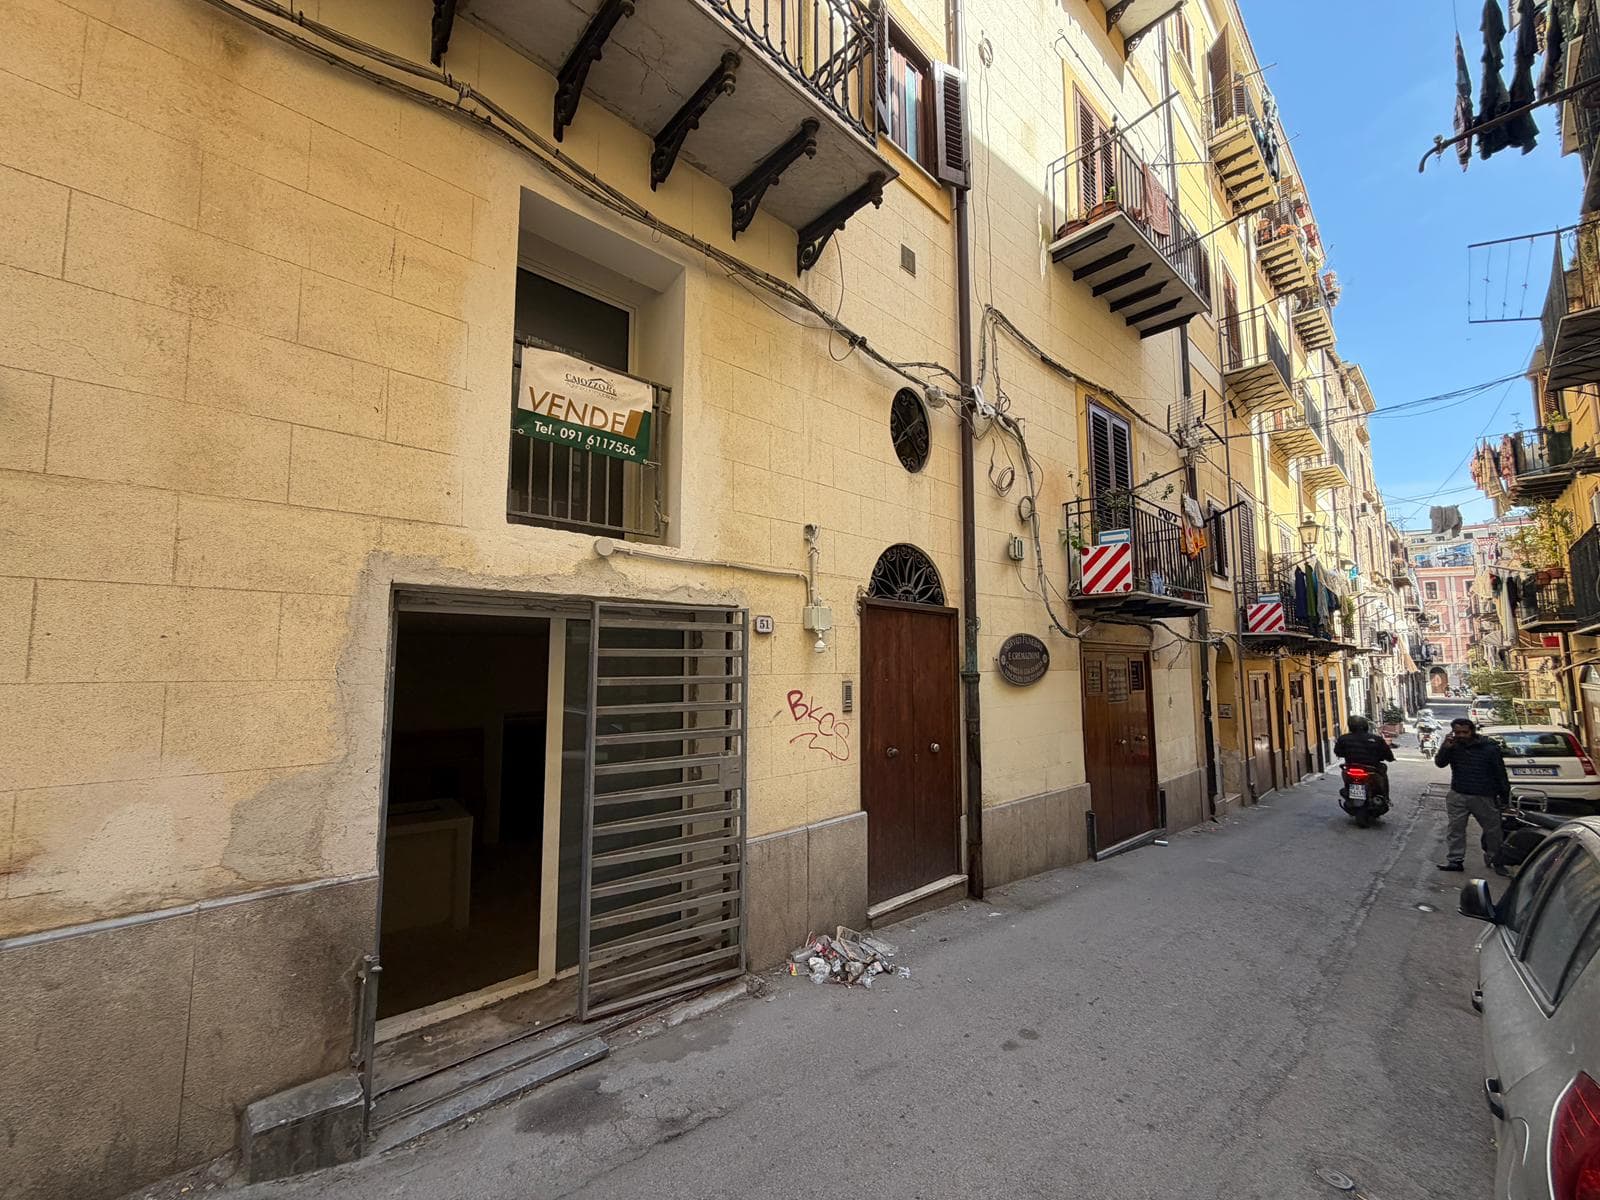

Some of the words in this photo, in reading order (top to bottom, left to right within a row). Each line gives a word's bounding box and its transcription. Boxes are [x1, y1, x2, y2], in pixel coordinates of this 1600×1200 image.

[528, 386, 626, 435] VENDE
[534, 420, 556, 436] Tel.
[560, 427, 583, 443] 091
[586, 434, 636, 456] 6117556
[759, 619, 770, 629] 51
